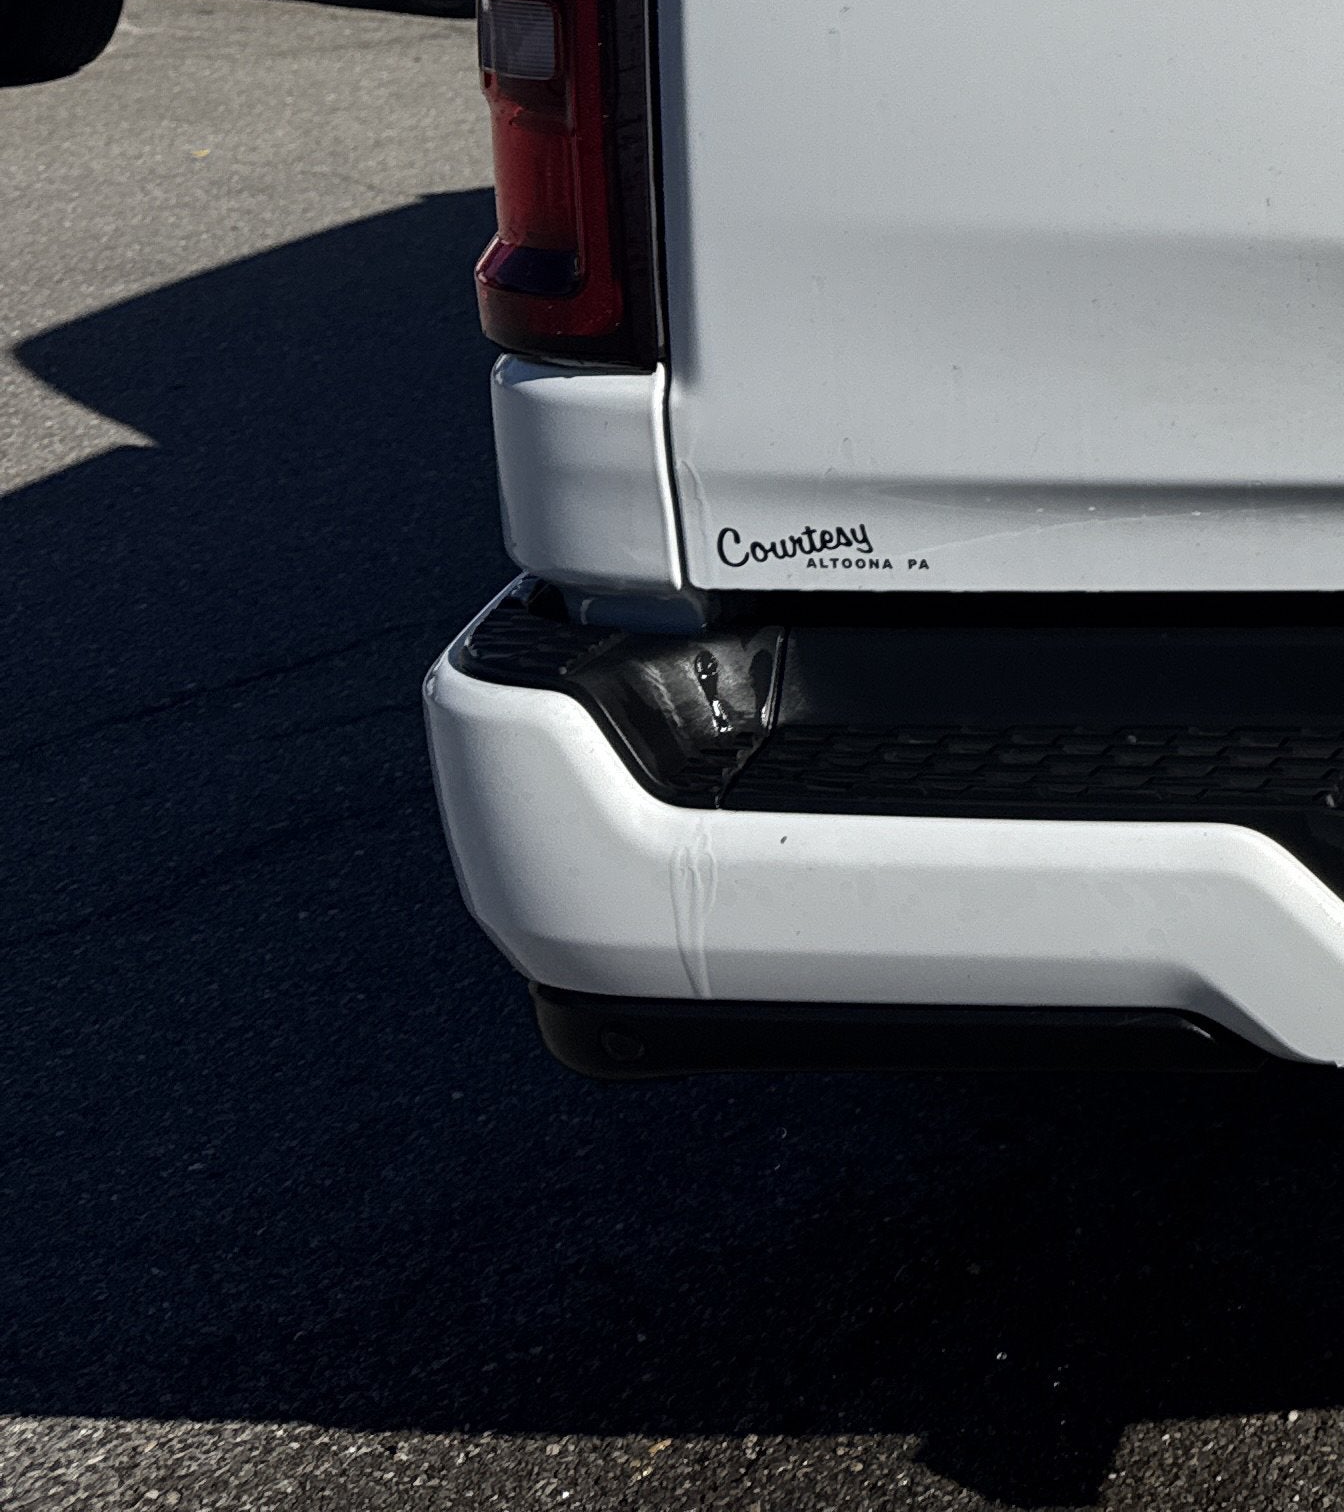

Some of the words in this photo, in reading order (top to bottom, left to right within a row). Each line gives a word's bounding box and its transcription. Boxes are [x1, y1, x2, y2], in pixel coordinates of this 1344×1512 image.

[716, 523, 874, 568] Courtesy
[806, 557, 894, 570] ALTOONA
[907, 558, 930, 570] PA
